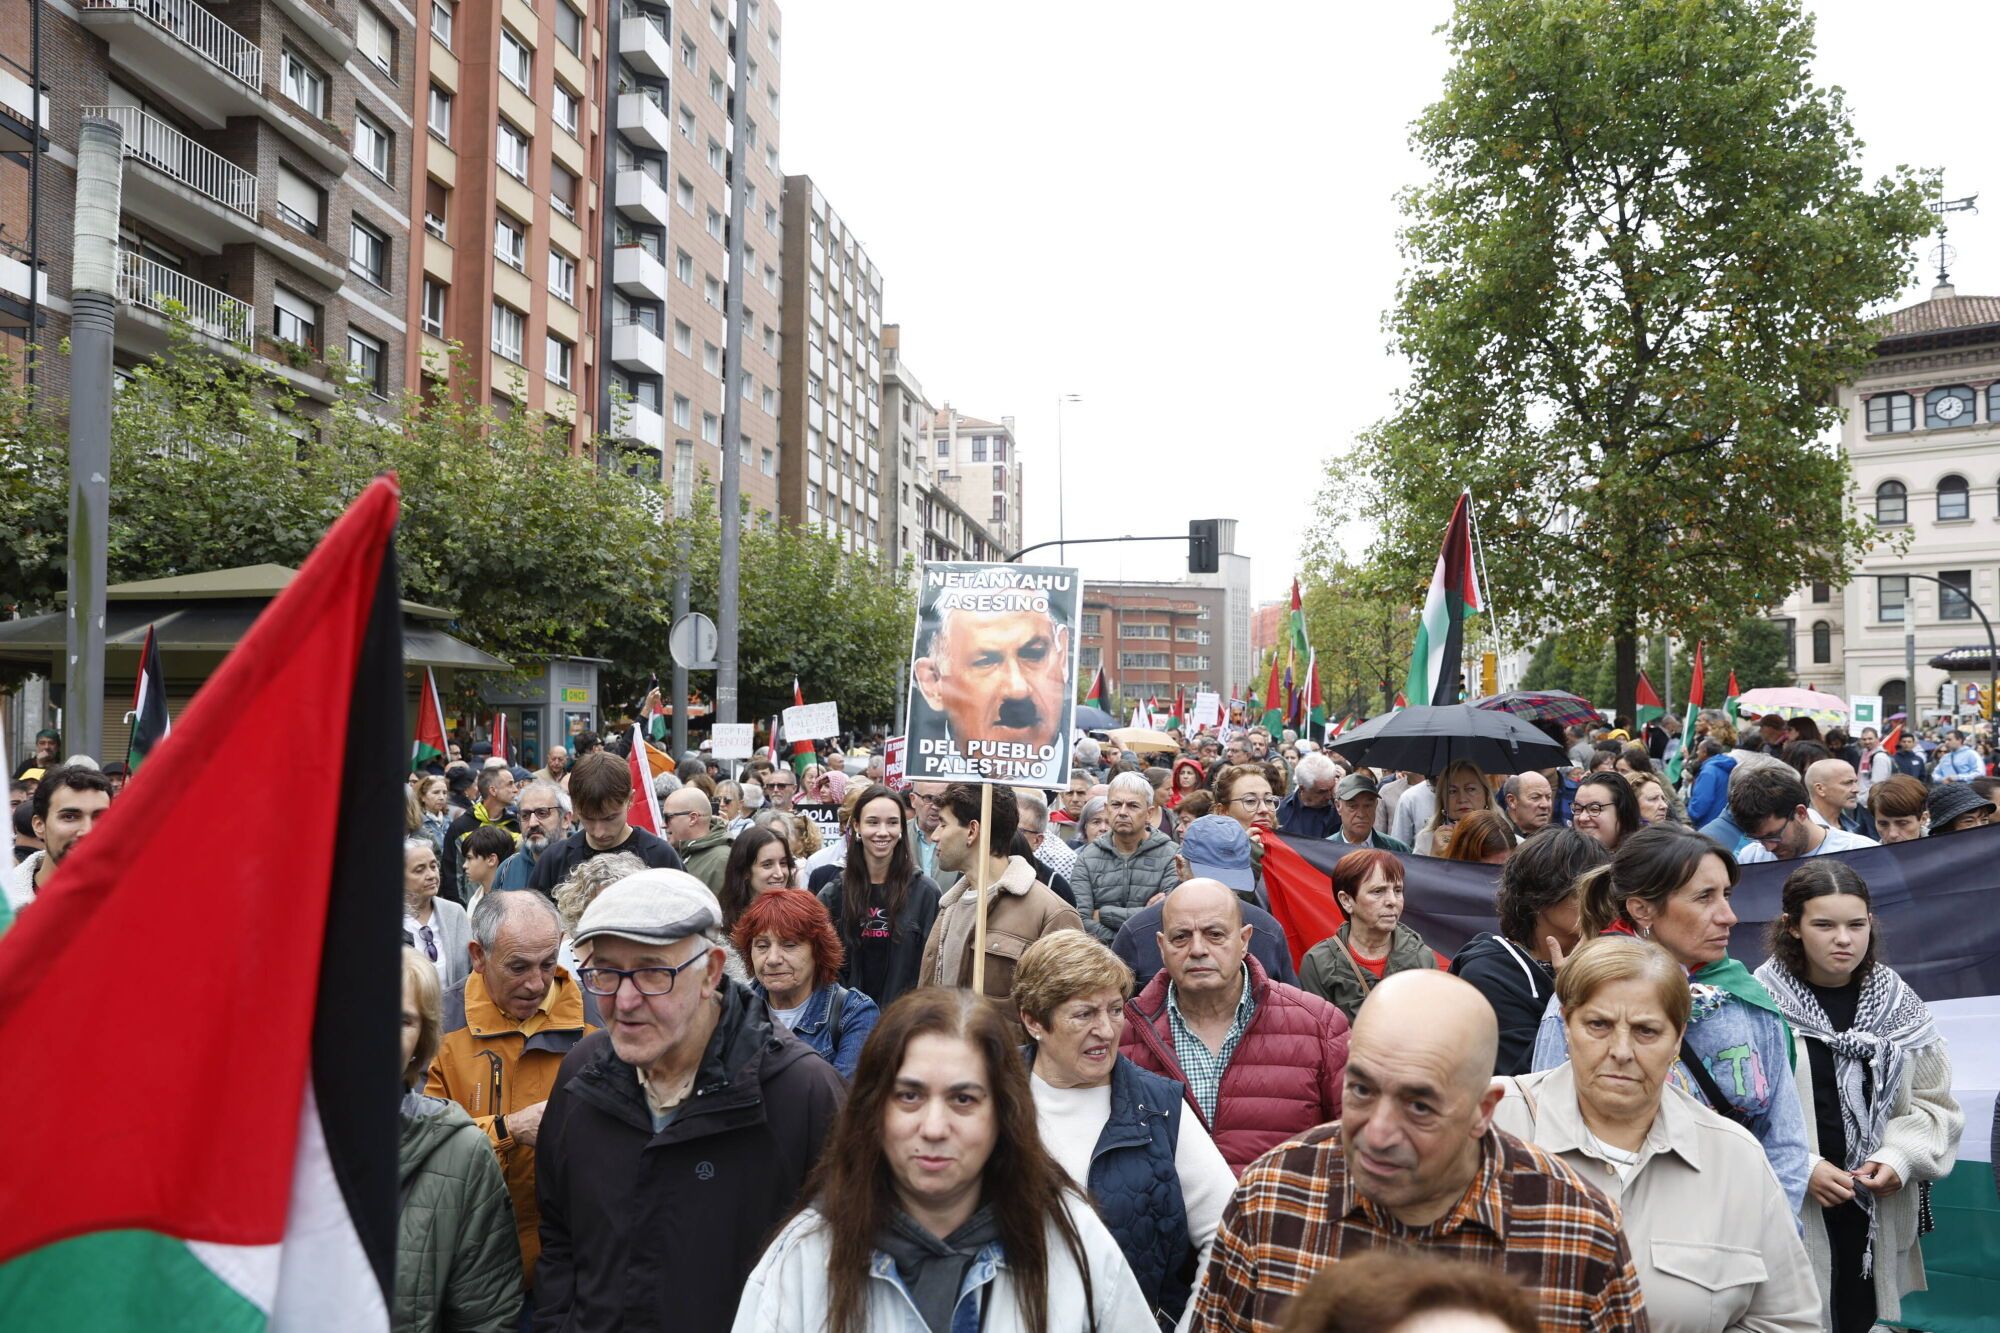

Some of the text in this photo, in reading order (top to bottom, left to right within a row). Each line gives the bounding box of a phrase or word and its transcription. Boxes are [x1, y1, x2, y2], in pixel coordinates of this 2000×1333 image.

[928, 571, 1071, 591] NETANYAHU
[944, 593, 1049, 613] ASESINO
[568, 690, 587, 701] ONCE
[716, 727, 752, 736] STOP THE
[919, 739, 1055, 761] DEL PUEBLO
[925, 756, 1048, 778] PALESTINO
